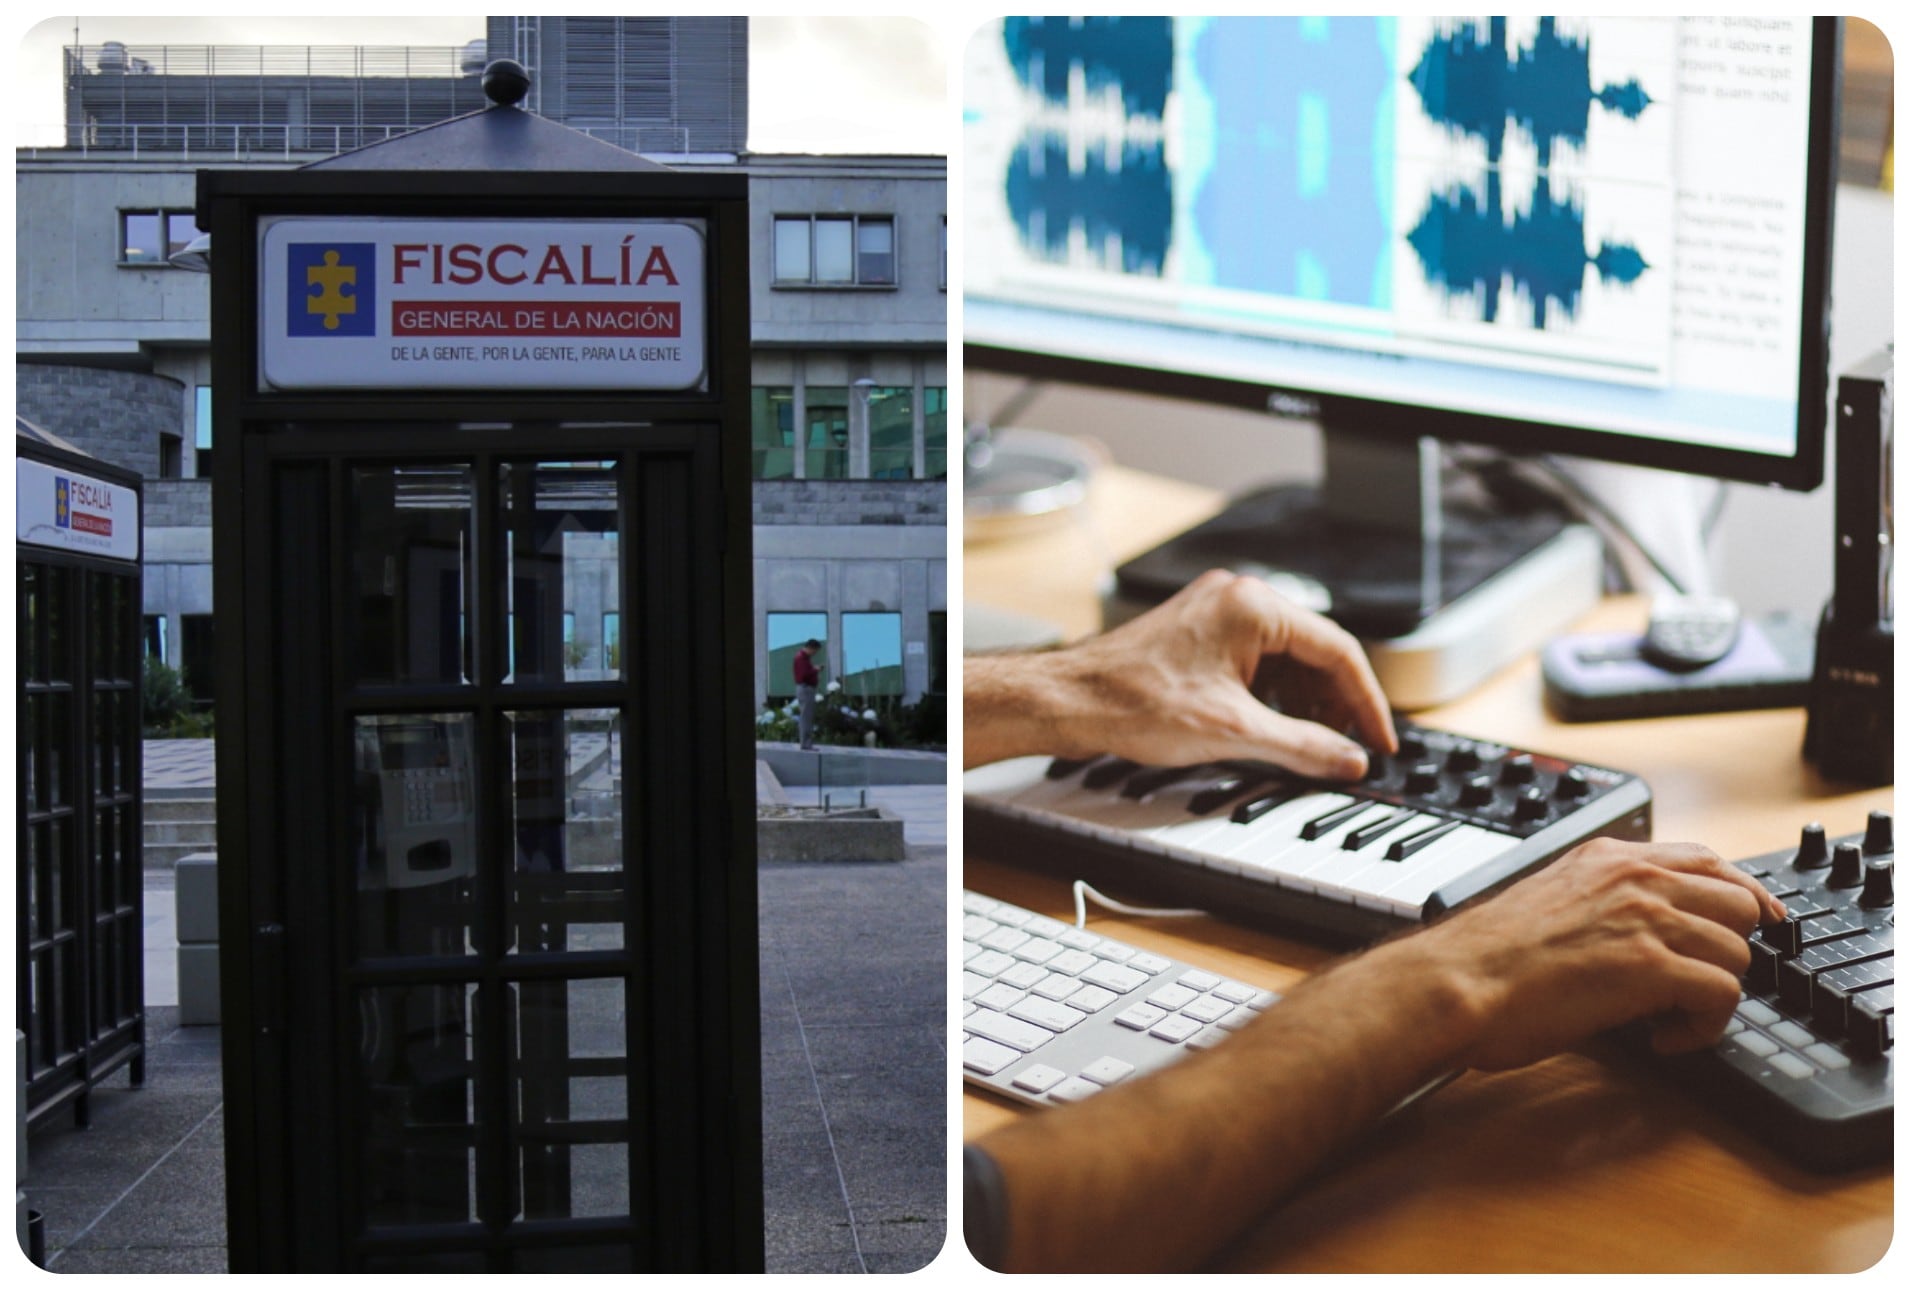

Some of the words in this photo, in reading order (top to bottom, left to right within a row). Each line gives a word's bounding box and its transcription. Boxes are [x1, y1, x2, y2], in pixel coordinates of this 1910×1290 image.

[392, 234, 680, 286] FISCALÍA
[400, 311, 509, 329] GENERAL
[515, 311, 545, 329] DE
[553, 311, 581, 329] LA
[586, 306, 674, 329] NACIÓN
[392, 347, 409, 361] DE
[413, 347, 430, 361] LA
[433, 346, 479, 363] GENTE,
[483, 347, 509, 361] POR
[512, 347, 530, 361] LA
[533, 347, 578, 363] GENTE,
[582, 347, 616, 361] PARA
[620, 347, 637, 361] LA
[640, 347, 681, 361] GENTE
[71, 481, 113, 512] FISCALÍA
